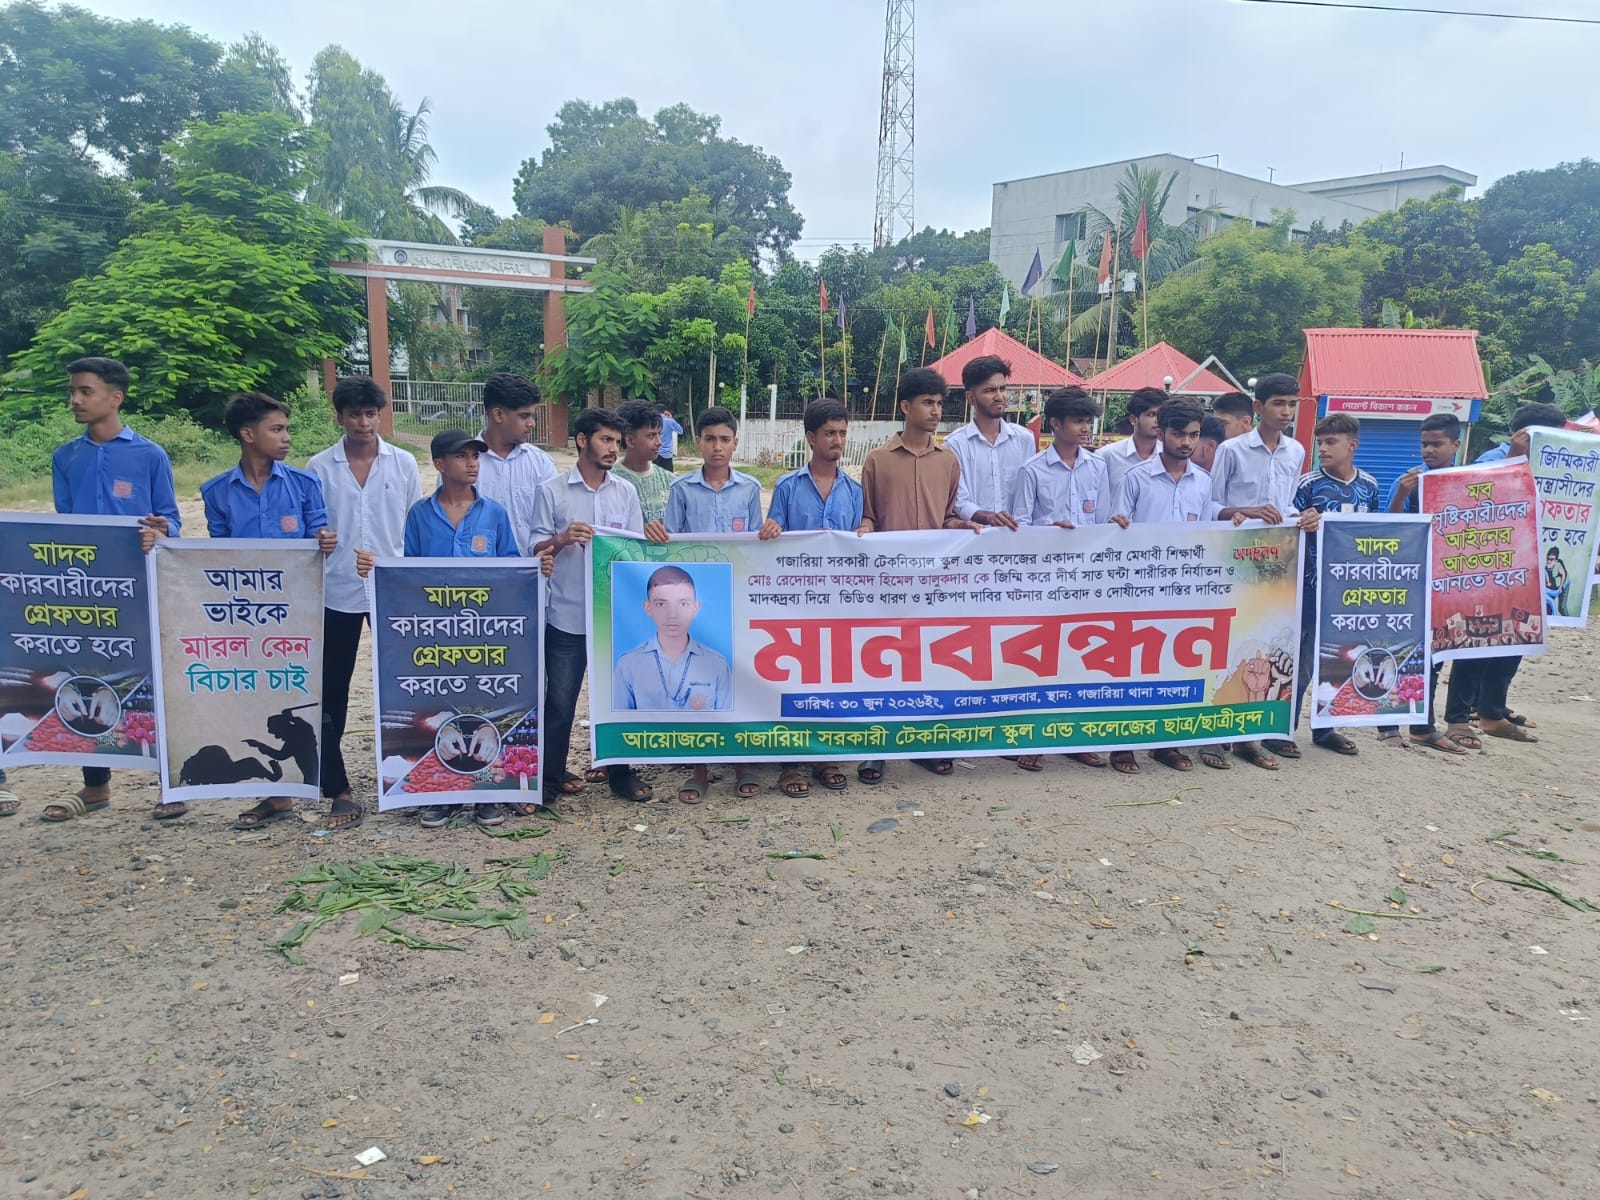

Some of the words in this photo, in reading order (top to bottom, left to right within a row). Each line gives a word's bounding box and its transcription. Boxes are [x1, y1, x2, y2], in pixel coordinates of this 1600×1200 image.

[1342, 401, 1368, 411] পেমেন্ট
[1369, 401, 1394, 412] বিকাশ
[1540, 445, 1600, 473] জিম্মিকারী
[1466, 481, 1495, 501] মব
[1431, 500, 1530, 535] সৃষ্টিকারীদের
[1354, 536, 1401, 556] মাদক
[1445, 526, 1514, 551] আইনের
[1564, 528, 1587, 547] হবে
[28, 541, 98, 567] মাদক
[776, 553, 823, 568] গজারিয়া
[826, 553, 870, 568] সরকারী
[874, 554, 936, 569] টেকনিক্যাল
[940, 556, 961, 570] স্কুল
[964, 555, 984, 566] এন্ড
[987, 554, 1038, 566] কলেজের
[1042, 552, 1085, 564] একাদশ
[1090, 548, 1122, 563] শ্রেণীর
[1126, 546, 1162, 561] মেধাবী
[1166, 545, 1206, 560] শিক্ষার্থী
[1233, 544, 1281, 561] অপহরণ
[1442, 549, 1515, 573] আওতায়
[204, 568, 284, 592] আমার
[776, 575, 827, 587] রেদোয়ান
[830, 574, 876, 587] আহমেদ
[878, 572, 914, 587] হিমেল
[917, 573, 969, 588] তালুকদার
[973, 573, 990, 584] কে
[993, 570, 1023, 584] জিম্মি
[1026, 571, 1051, 583] করে
[1056, 567, 1079, 583] দীর্ঘ
[1081, 569, 1104, 582] সাত
[1134, 565, 1178, 579] শারীরিক
[1181, 563, 1222, 578] নির্যাতন
[1225, 566, 1235, 576] ও
[1328, 557, 1421, 582] কারবারীদের
[1432, 572, 1488, 594] আনতে
[1492, 567, 1529, 590] হবে
[0, 567, 137, 598] কারবারীদের
[749, 593, 801, 606] মাদকদ্রব্য
[805, 590, 830, 605] দিয়ে
[840, 590, 875, 605] ভিডিও
[879, 593, 907, 605] ধারণ
[911, 593, 921, 603] ও
[924, 589, 967, 606] মুক্তিপণ
[969, 588, 1001, 604] দাবির
[1005, 589, 1043, 602] ঘটনার
[1047, 586, 1089, 601] প্রতিবাদ
[1094, 588, 1103, 598] ও
[1106, 583, 1155, 599] দোষীদের
[1159, 582, 1191, 597] শাস্তির
[1195, 581, 1233, 595] দাবিতে
[424, 584, 492, 608] মাদক
[1342, 587, 1408, 608] গ্রেফতার
[25, 602, 119, 629] গ্রেফতার
[203, 596, 290, 628] ভাইকে
[388, 608, 527, 638] কারবারীদের
[1330, 613, 1381, 631] করতে
[1385, 613, 1414, 632] হবে
[10, 633, 82, 655] করতে
[88, 636, 136, 659] হবে
[180, 635, 251, 660] মারল
[261, 637, 312, 660] কেন
[412, 643, 507, 668] গ্রেফতার
[749, 607, 1237, 685] মানববন্ধন
[185, 663, 258, 693] বিচার
[265, 662, 309, 695] চাই
[397, 675, 469, 696] করতে
[475, 674, 522, 697] হবে
[839, 699, 859, 709] ৩০
[862, 697, 884, 711] জুন
[1077, 685, 1124, 701] গজারিয়া
[1128, 685, 1153, 698] থানা
[1157, 685, 1191, 699] সংলগ্ন
[734, 725, 812, 748] গজারিয়া
[817, 725, 889, 748] সরকারী
[895, 723, 996, 745] টেকনিক্যাল
[1000, 723, 1035, 746] স্কুল
[1041, 722, 1075, 739] এন্ড
[1079, 719, 1158, 738] কলেজের
[1162, 707, 1265, 734] ছাত্র/ছাত্রীবৃন্দ
